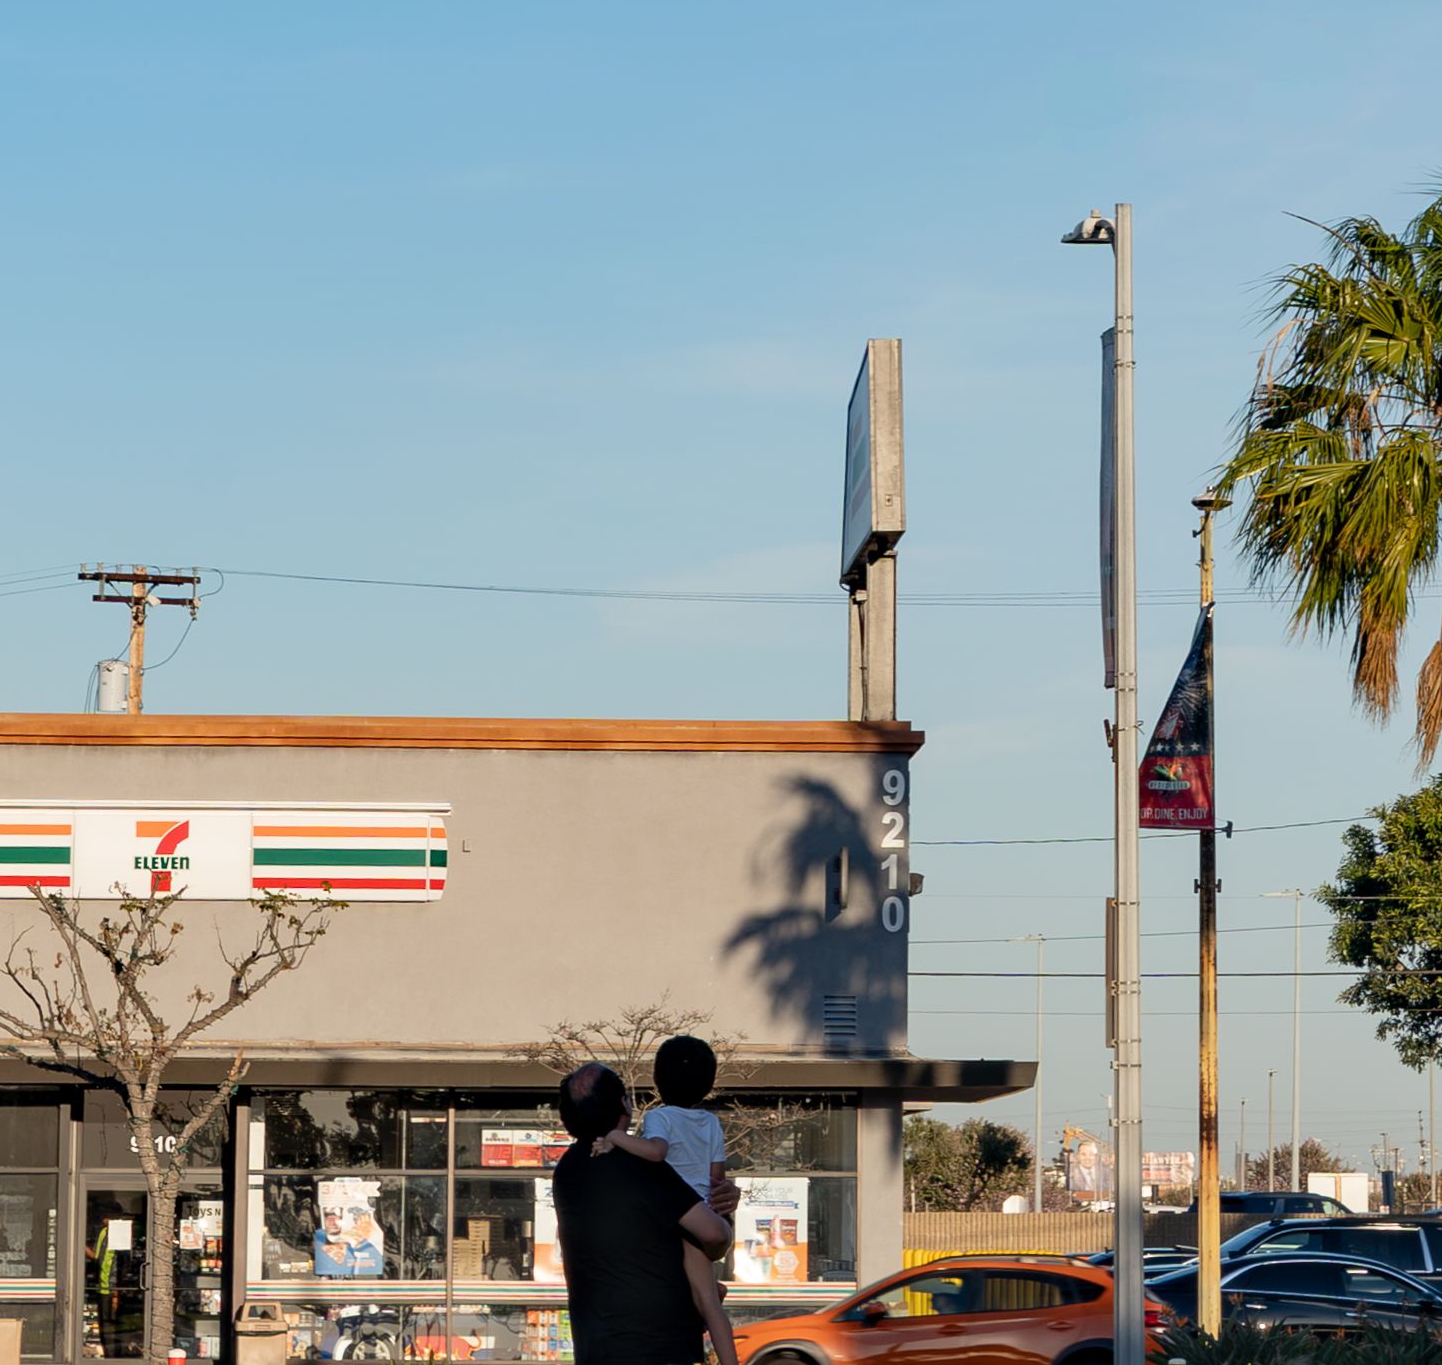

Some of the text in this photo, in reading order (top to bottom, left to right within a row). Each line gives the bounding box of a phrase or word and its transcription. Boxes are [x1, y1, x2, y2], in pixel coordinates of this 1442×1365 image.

[1178, 808, 1208, 820] ENJOY
[880, 769, 906, 933] 9210
[130, 1135, 177, 1154] 910
